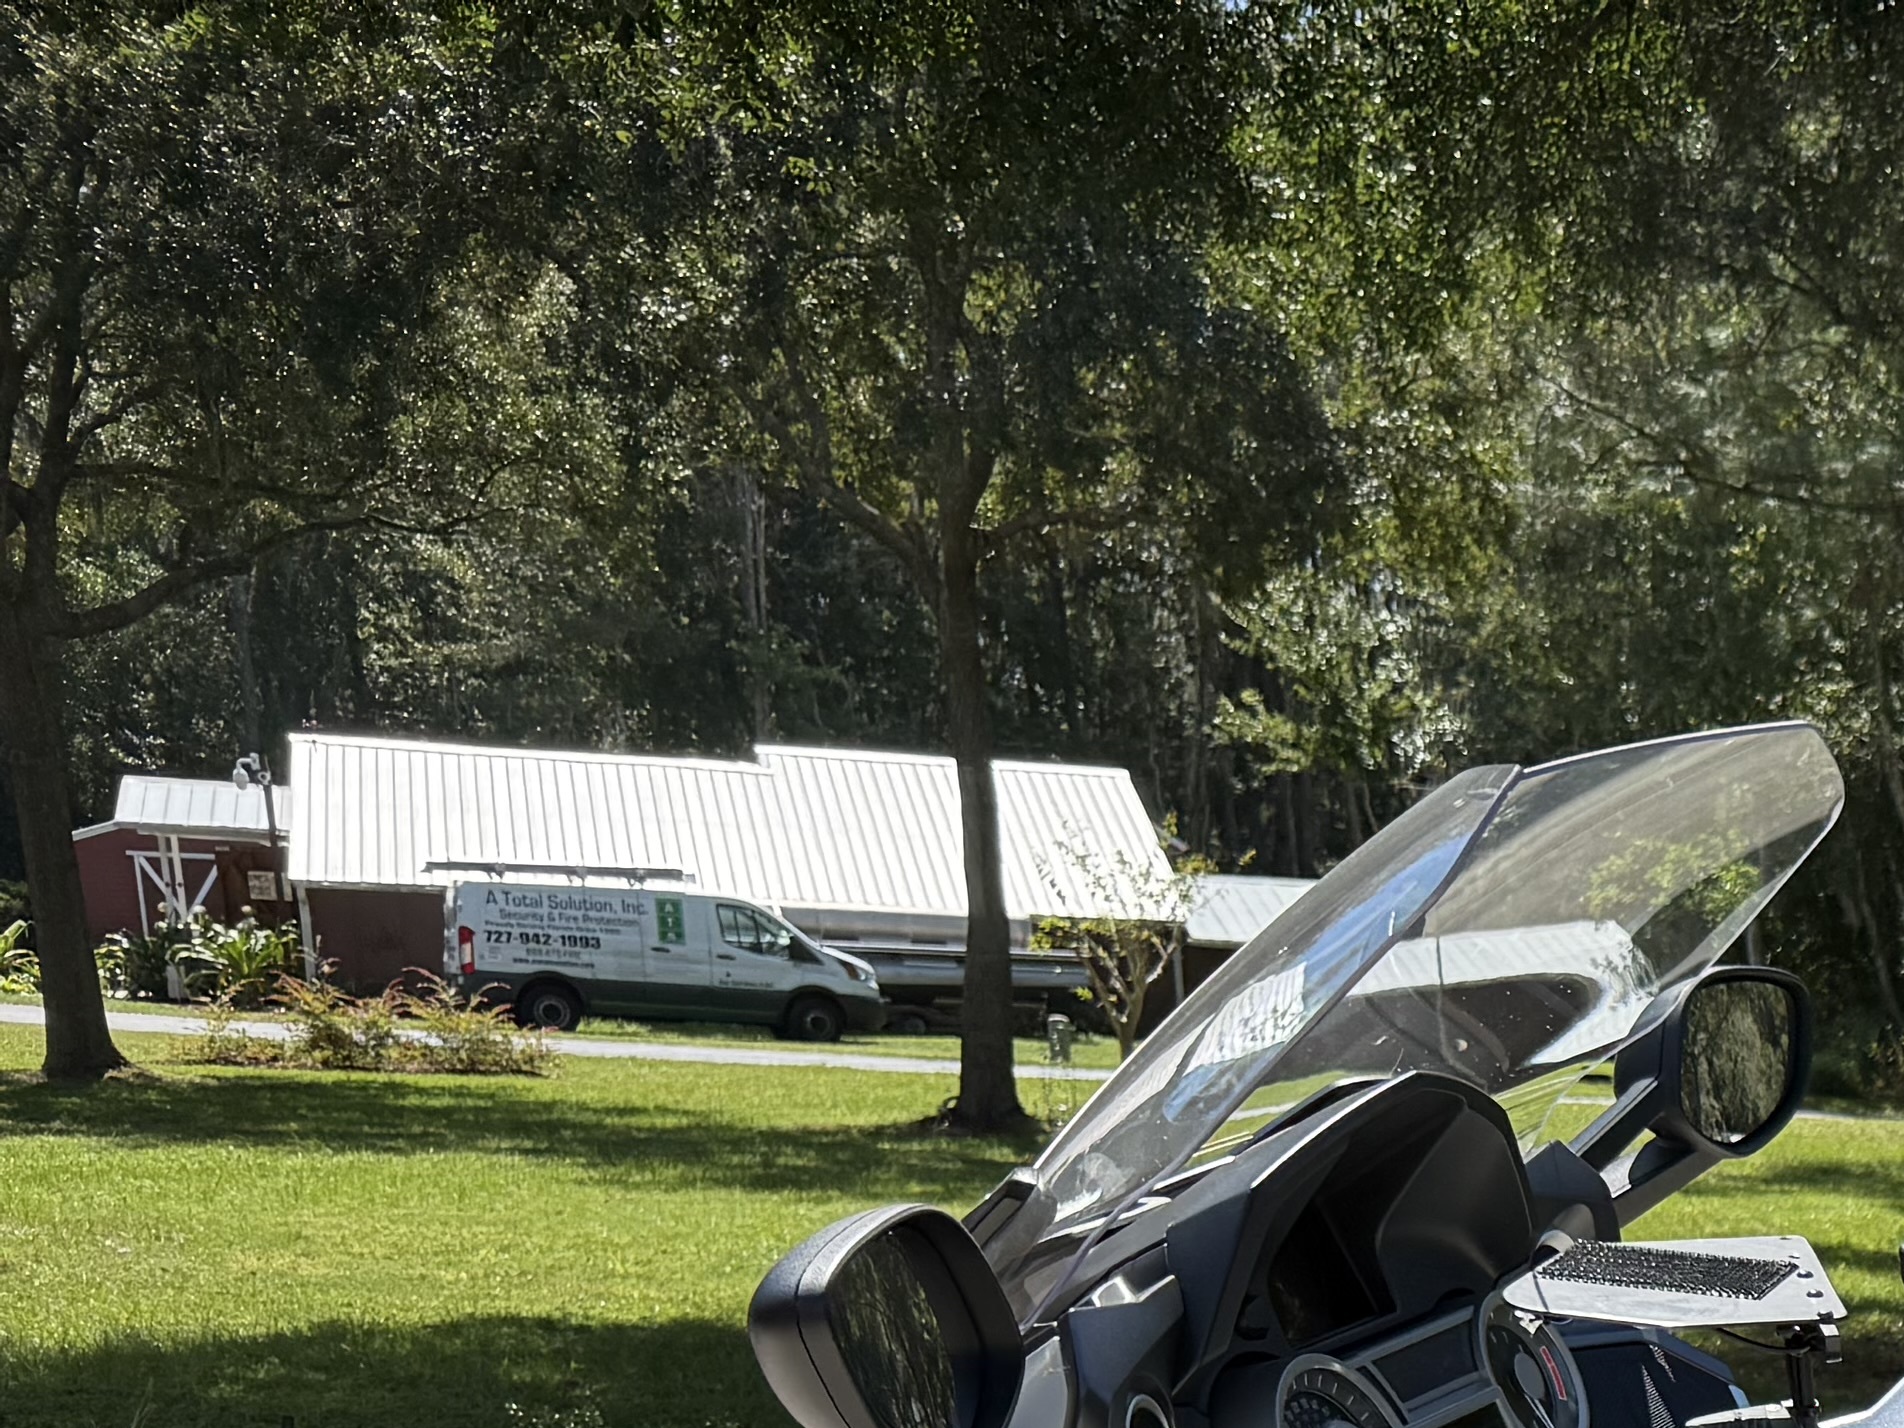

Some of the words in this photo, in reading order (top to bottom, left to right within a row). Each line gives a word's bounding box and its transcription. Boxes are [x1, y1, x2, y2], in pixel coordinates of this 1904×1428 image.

[486, 889, 498, 905] A
[501, 890, 543, 909] Total
[547, 894, 617, 914] Solution,
[621, 899, 649, 915] Inc.
[499, 908, 544, 922] Security
[547, 911, 556, 922] &
[558, 911, 579, 924] Fire
[582, 913, 640, 928] Protection
[484, 929, 601, 949] 727-942-1993
